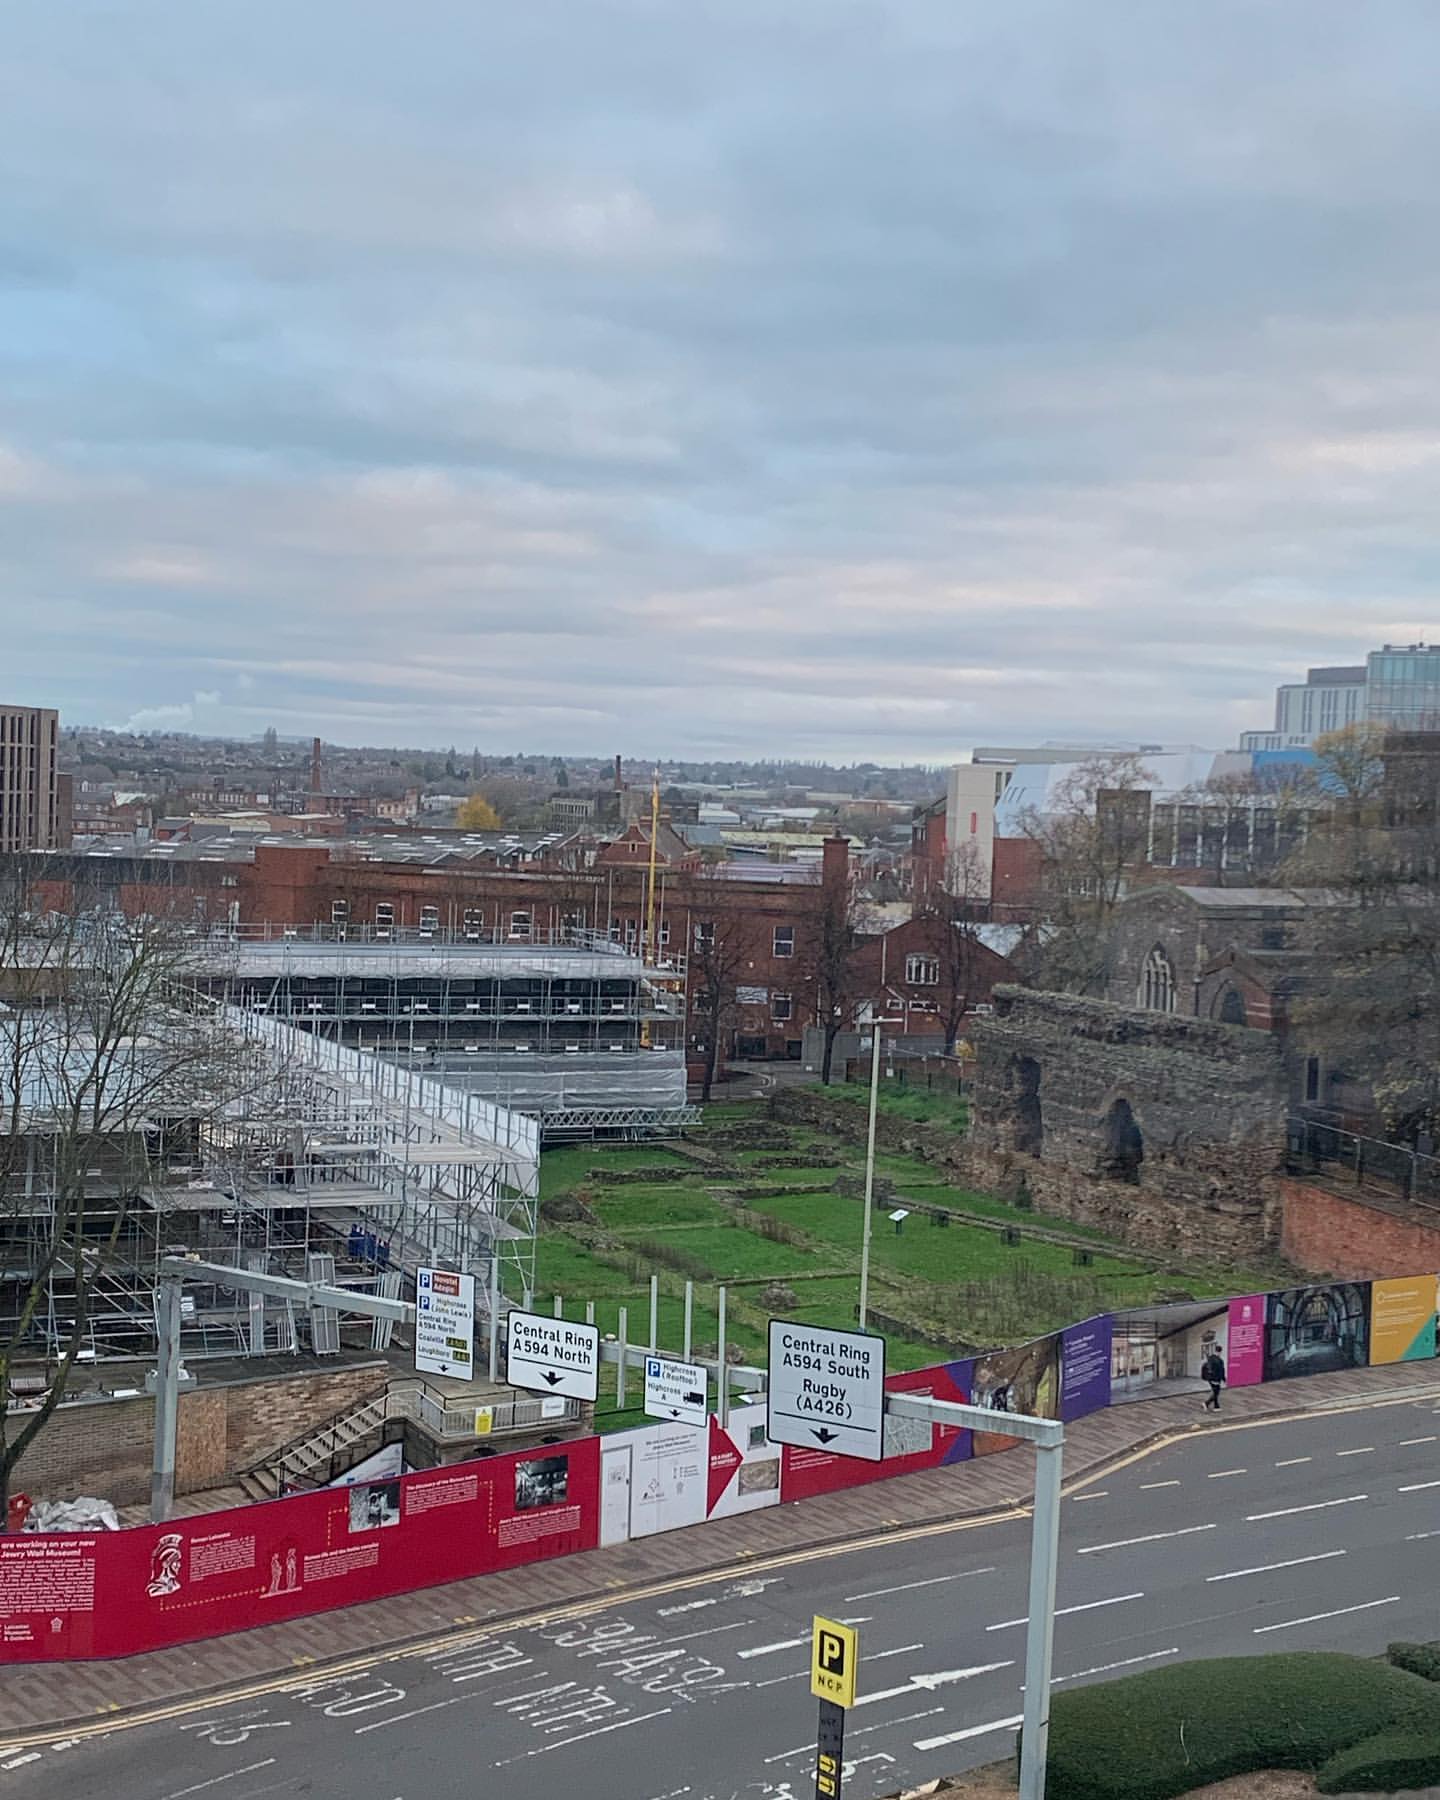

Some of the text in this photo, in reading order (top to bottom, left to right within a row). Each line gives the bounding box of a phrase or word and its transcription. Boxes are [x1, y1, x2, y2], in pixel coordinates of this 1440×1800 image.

[418, 1312, 457, 1327] Central Ring
[513, 1321, 593, 1351] Central Ring
[513, 1338, 591, 1365] A594 North
[782, 1334, 870, 1364] Central Ring
[783, 1352, 870, 1380] A594 South
[803, 1378, 846, 1401] Rugby
[796, 1394, 852, 1419] (A426)
[1, 1551, 26, 1559] Jewry
[26, 1549, 45, 1557] Wall
[16, 1540, 47, 1550] working
[60, 1541, 78, 1549] your
[822, 1633, 841, 1668] P
[818, 1674, 843, 1692] NCP
